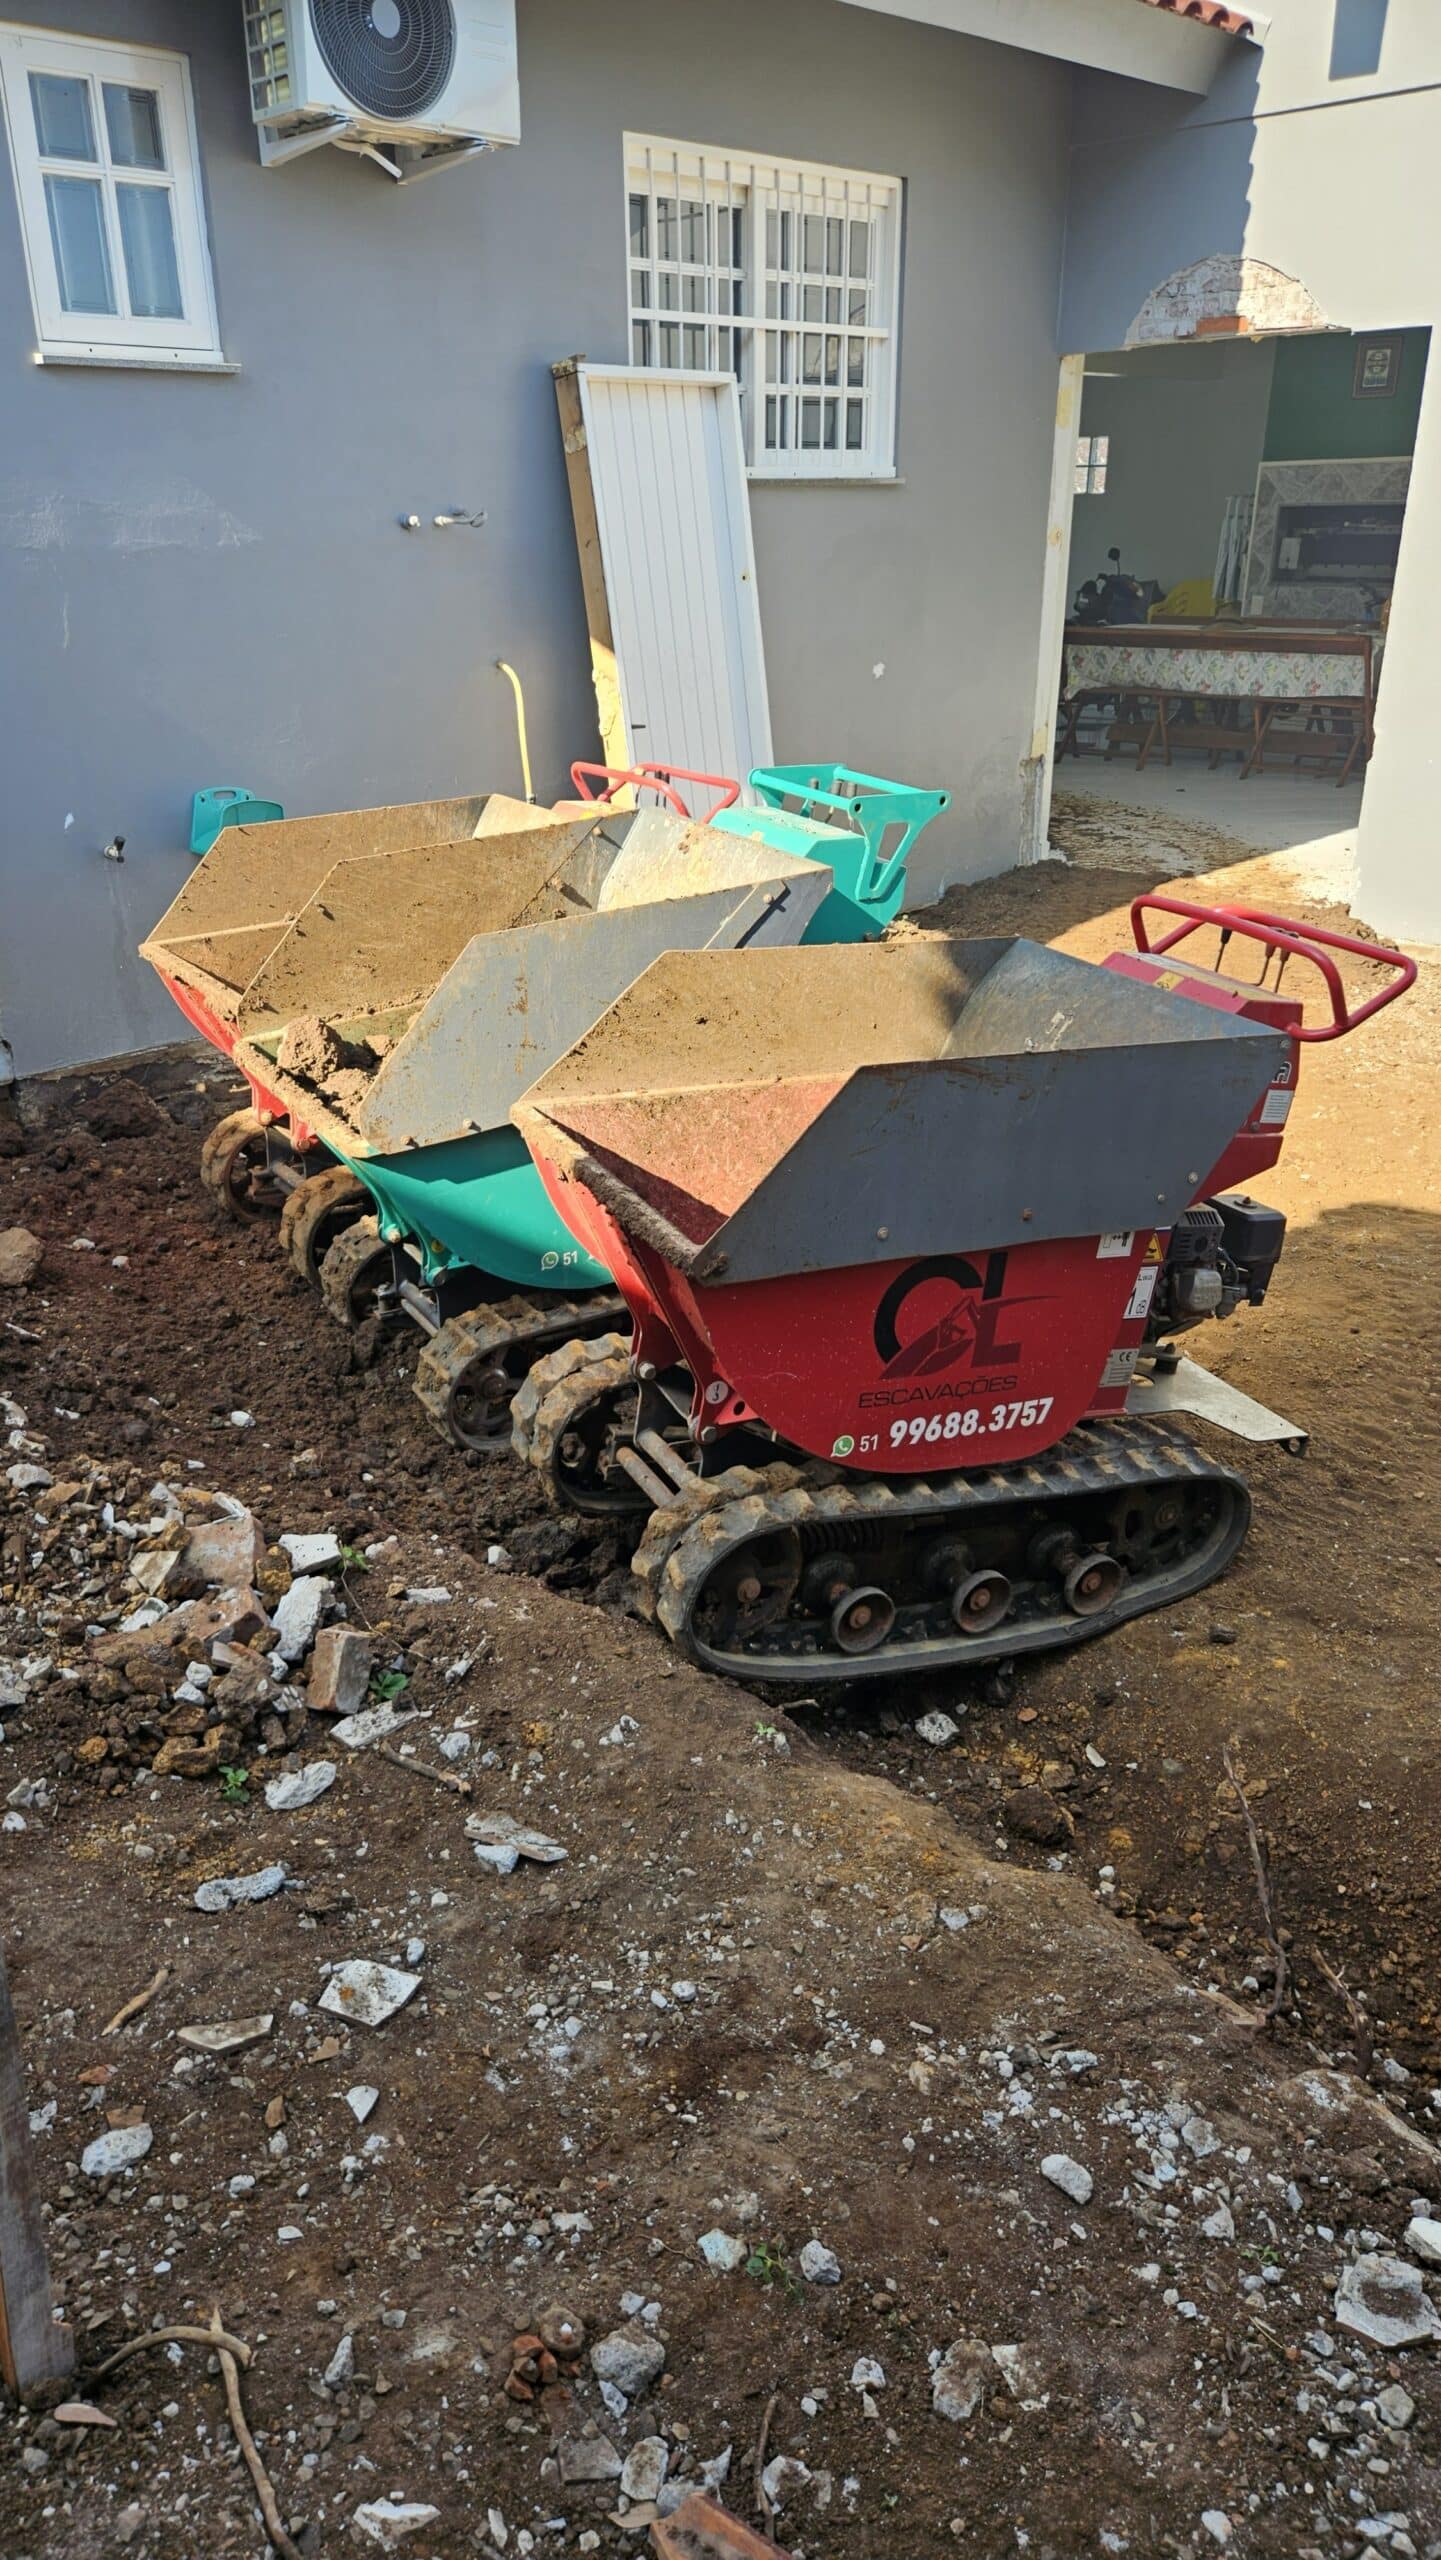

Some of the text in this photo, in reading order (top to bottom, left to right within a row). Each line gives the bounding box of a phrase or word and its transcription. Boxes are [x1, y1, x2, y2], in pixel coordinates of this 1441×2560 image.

[563, 1250, 578, 1266] 51
[1119, 1351, 1133, 1362] CE
[858, 1375, 1019, 1409] ESCAVAÇÕES
[859, 1396, 1055, 1453] 51 99688.3757
